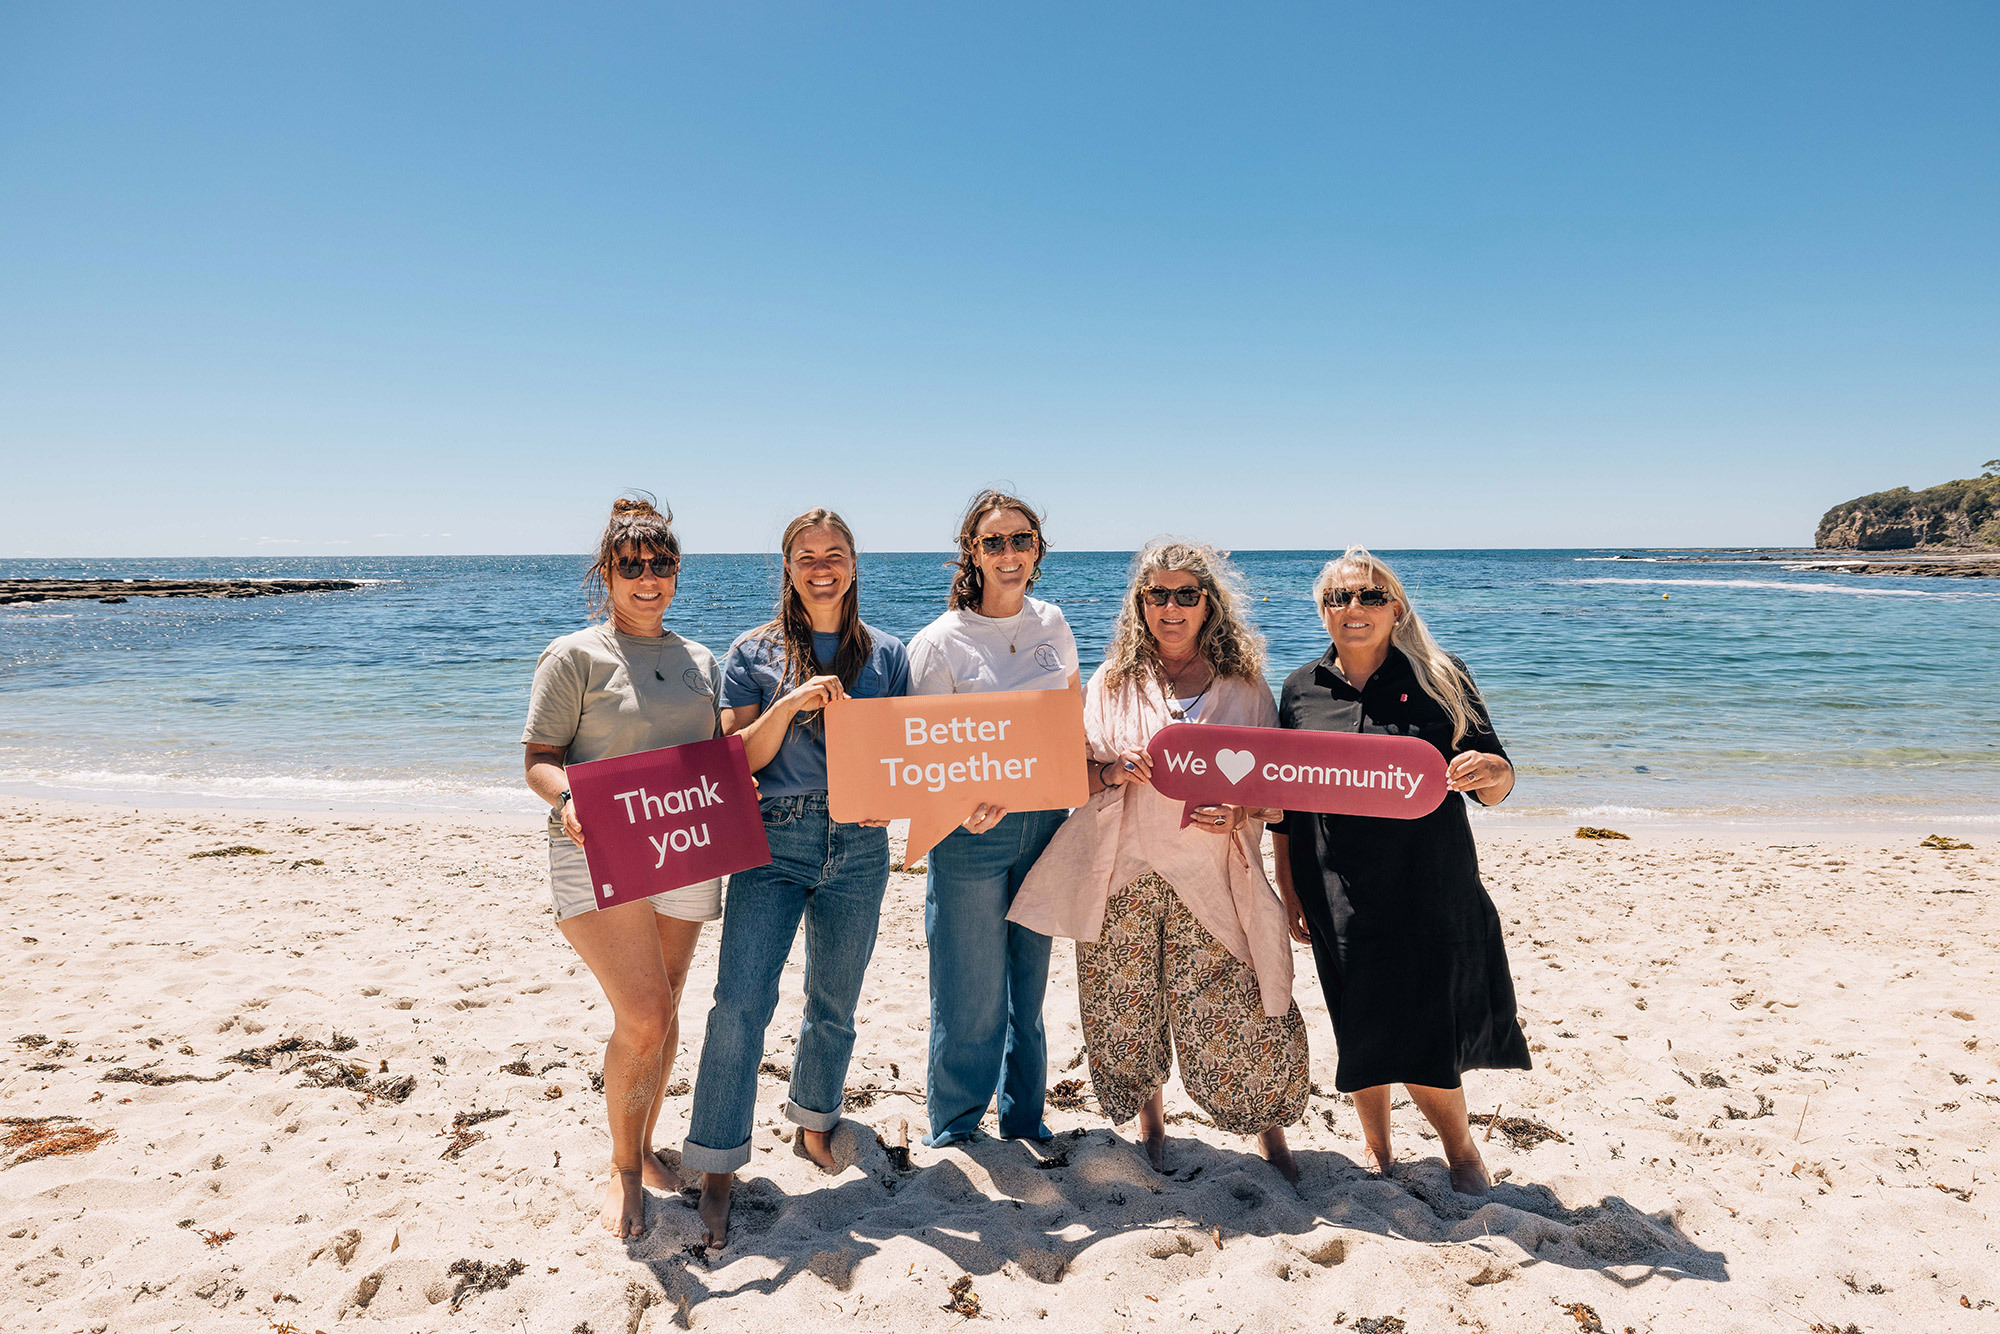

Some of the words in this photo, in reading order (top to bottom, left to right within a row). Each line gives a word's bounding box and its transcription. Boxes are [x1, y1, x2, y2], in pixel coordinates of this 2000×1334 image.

[905, 716, 1012, 746] Better
[879, 752, 1038, 792] Together
[1163, 749, 1207, 775] We
[1262, 763, 1425, 799] community
[613, 775, 724, 824] Thank
[648, 823, 711, 869] you
